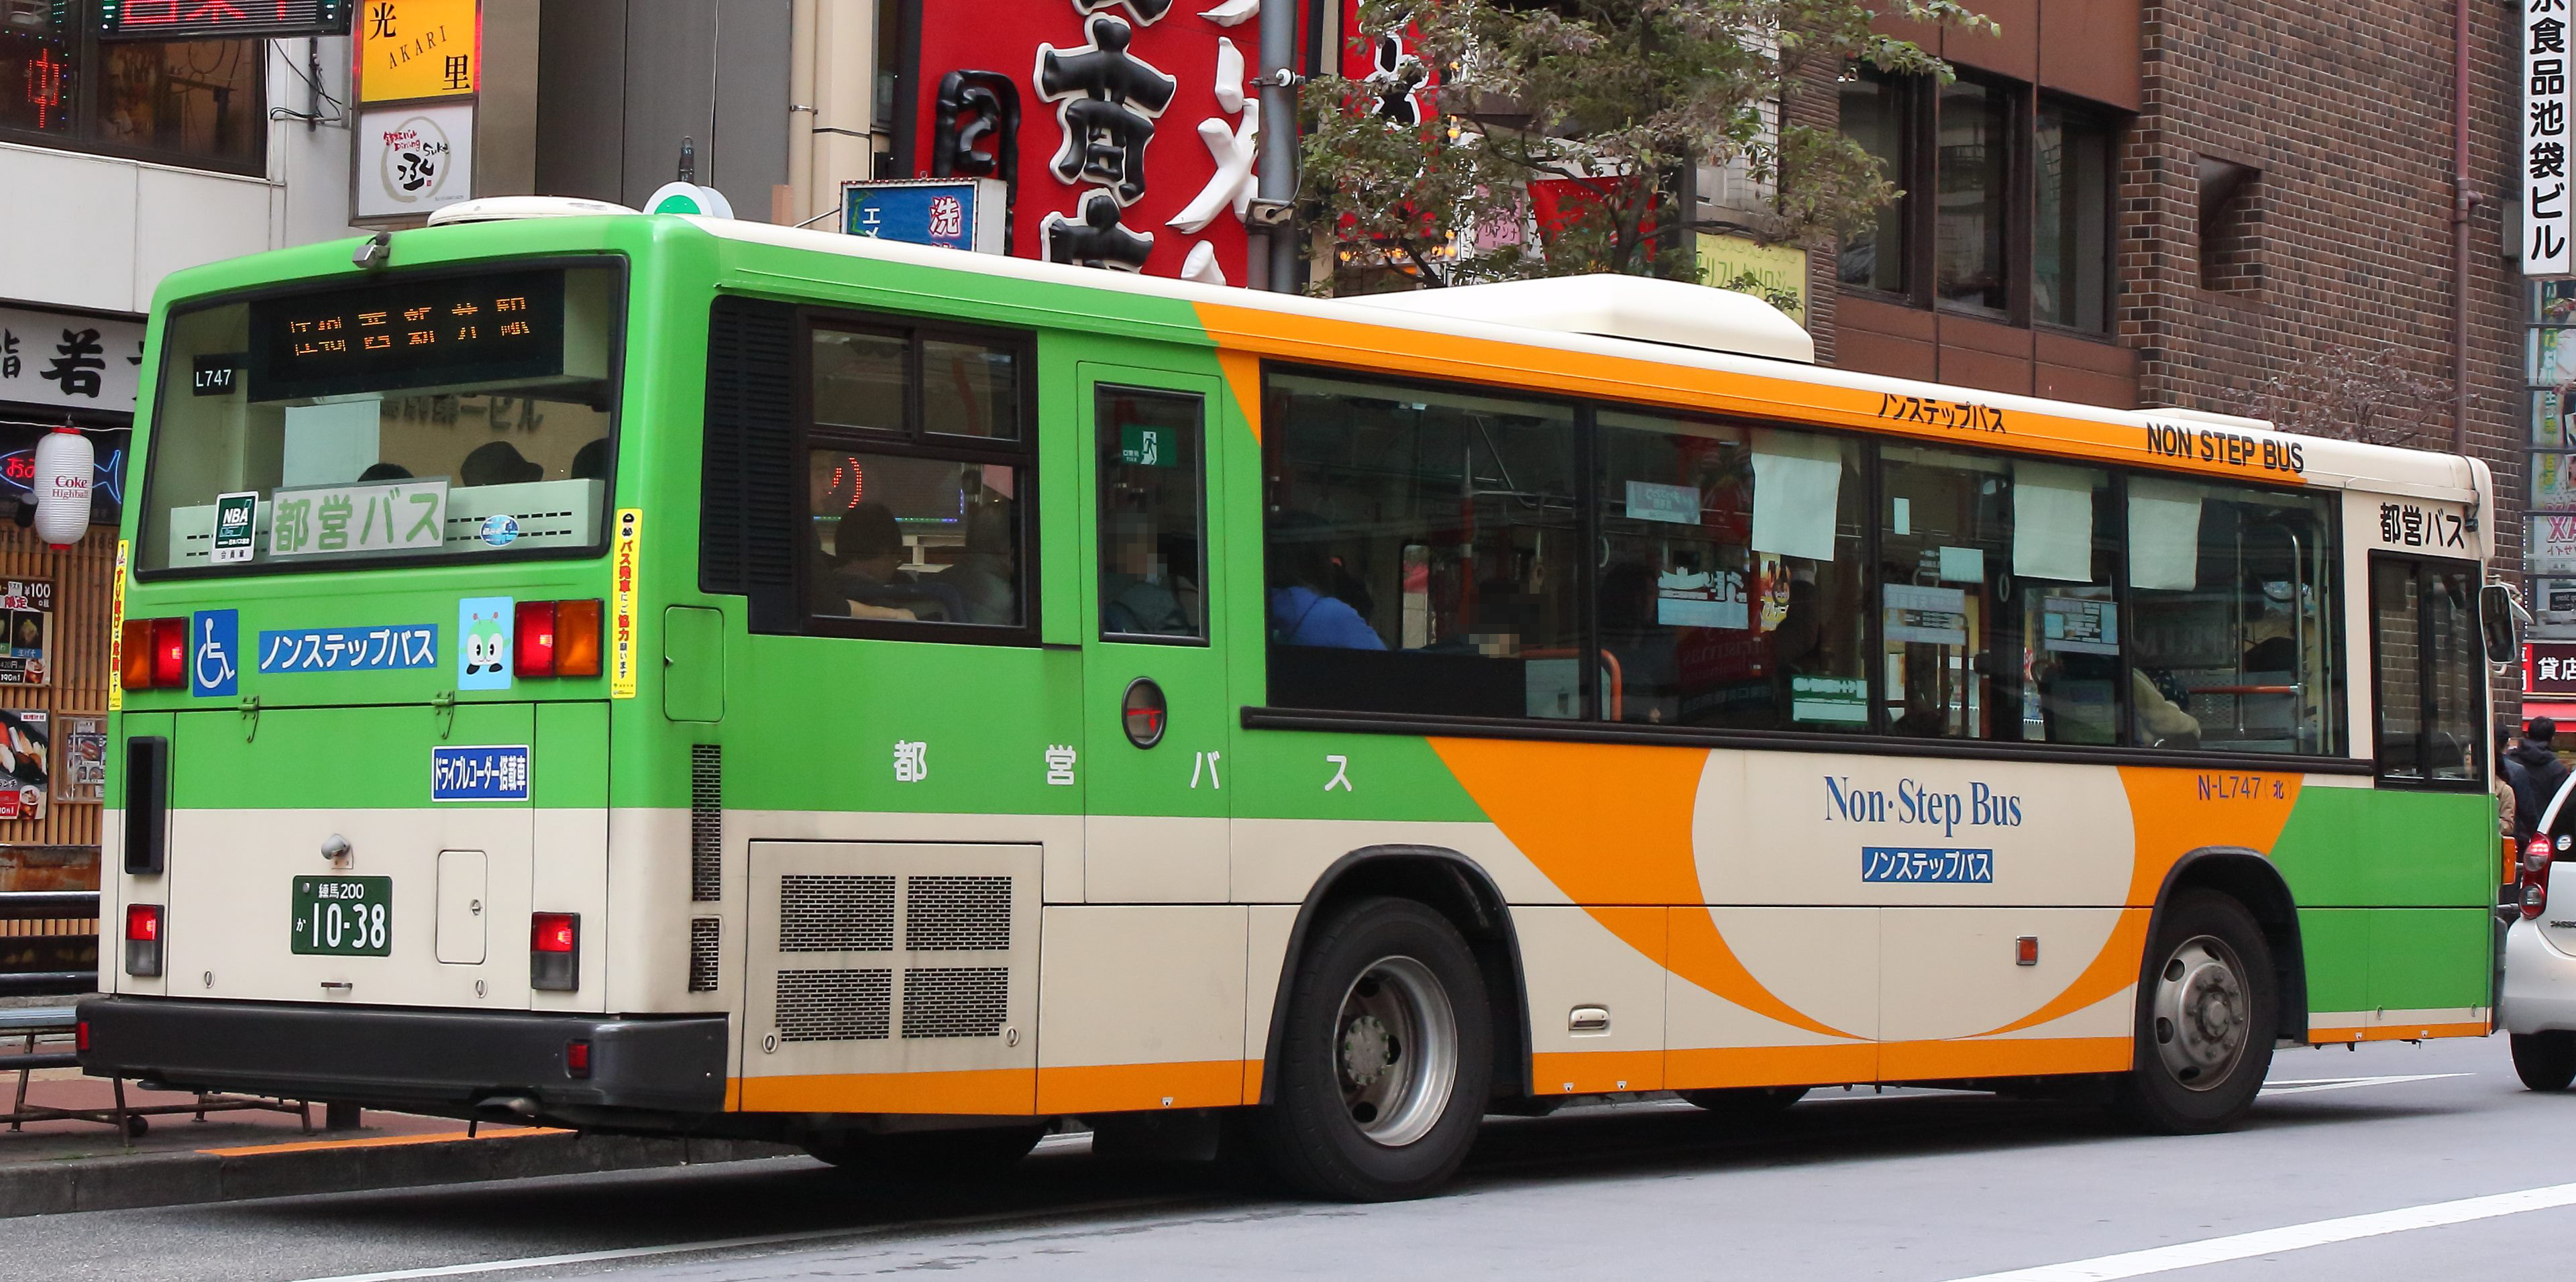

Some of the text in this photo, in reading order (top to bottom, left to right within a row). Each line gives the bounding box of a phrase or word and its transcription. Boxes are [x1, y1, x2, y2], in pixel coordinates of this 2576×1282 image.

[369, 2, 396, 41] 光
[389, 24, 447, 70] AKARI
[442, 54, 470, 91] 里
[394, 139, 421, 152] Dining
[195, 369, 231, 388] L747
[1878, 392, 2006, 435] ノンステップバス
[2147, 422, 2304, 474] NON STEP BUS
[52, 488, 89, 500] Highball
[55, 475, 87, 489] Coke
[223, 507, 249, 523] NBA
[276, 488, 440, 552] 都営バス
[2380, 502, 2465, 549] 都営バス
[24, 582, 51, 598] ¥100
[619, 539, 633, 679] バス発車にご協力願います
[260, 630, 435, 671] ノンステップバス
[435, 755, 527, 792] ドライブレコーダー搭載車
[1970, 781, 2022, 829] Bus
[1864, 849, 1992, 882] ノンステップバス
[296, 902, 386, 949] か 10-38
